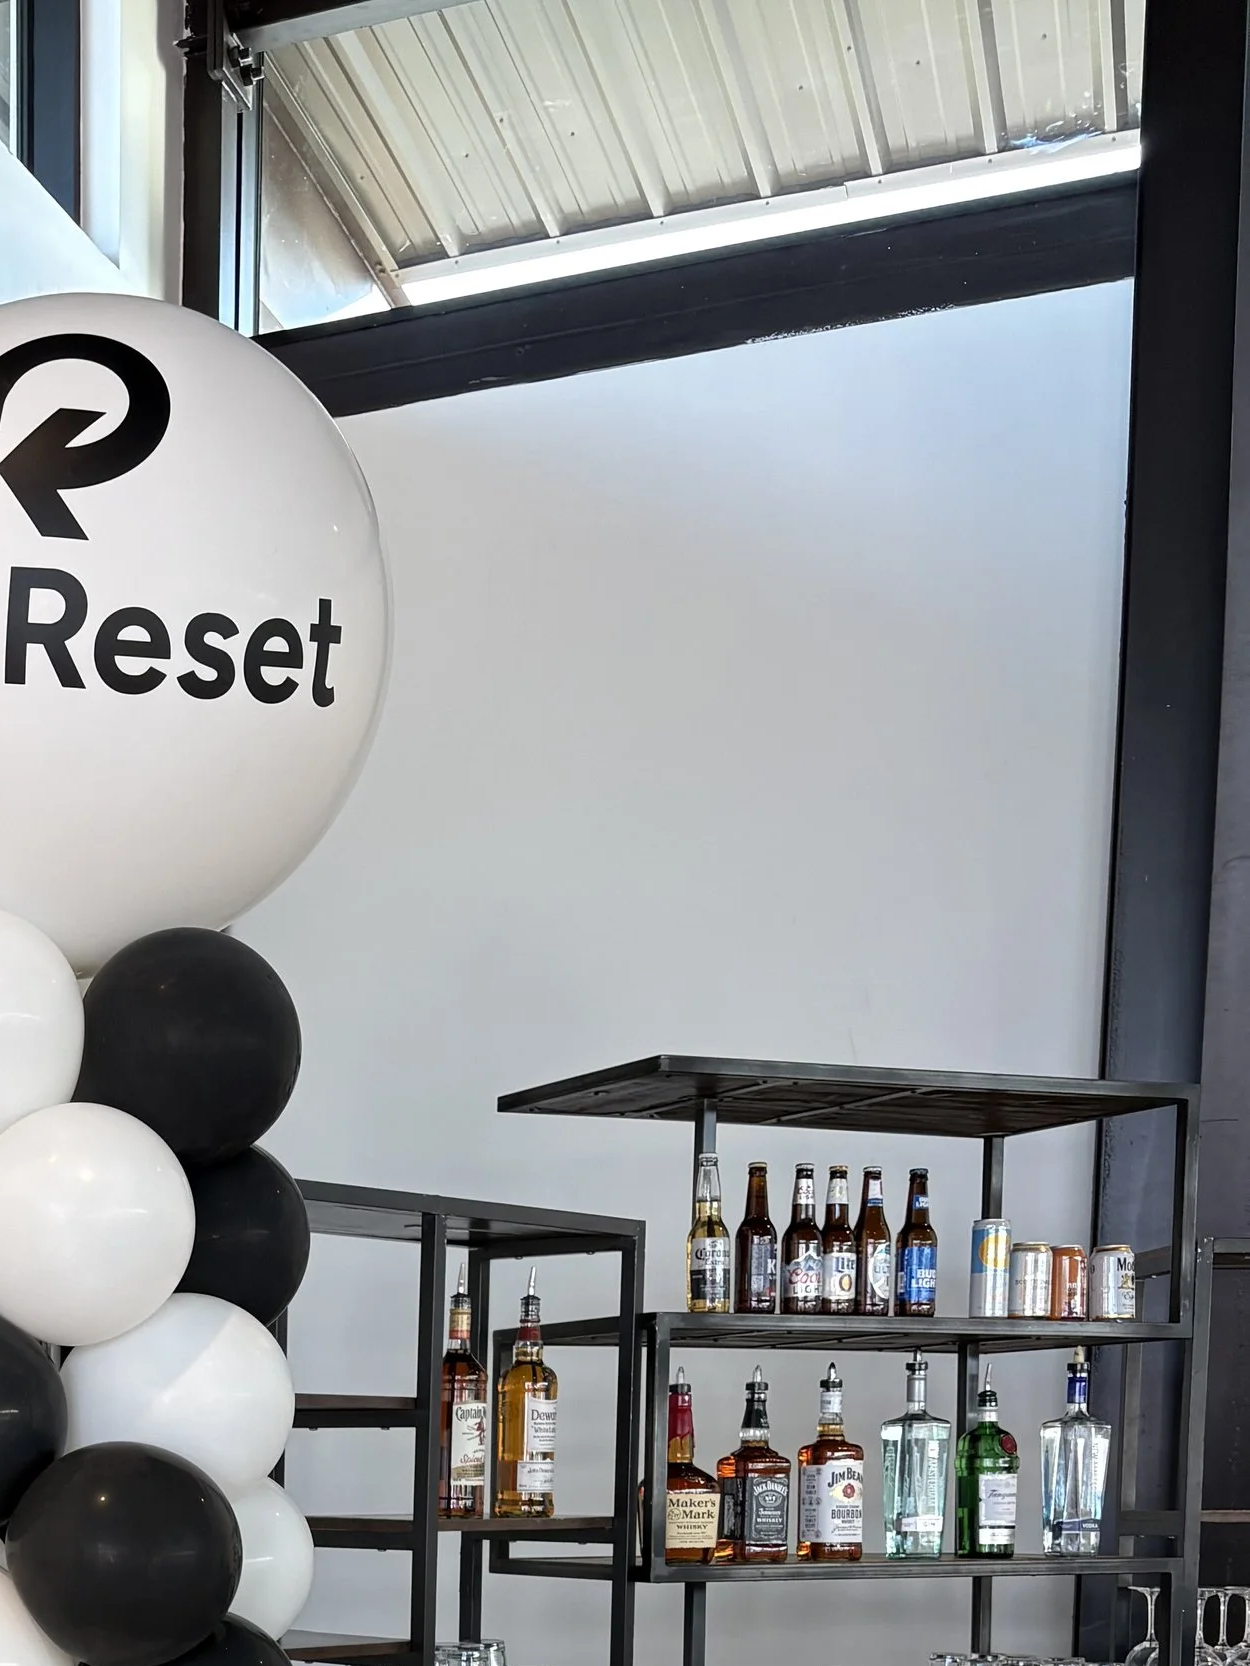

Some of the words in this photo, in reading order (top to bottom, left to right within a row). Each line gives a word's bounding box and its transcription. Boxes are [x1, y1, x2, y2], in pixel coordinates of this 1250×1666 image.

[3, 565, 343, 709] Reset
[833, 1257, 855, 1273] Lite
[788, 1267, 822, 1285] Coo
[792, 1285, 822, 1295] LIGH
[911, 1279, 936, 1288] LIGH
[455, 1406, 482, 1422] Captain
[827, 1471, 846, 1488] JIM
[668, 1498, 716, 1508] Maker's
[681, 1510, 716, 1520] Mark
[831, 1509, 862, 1520] BOURBON
